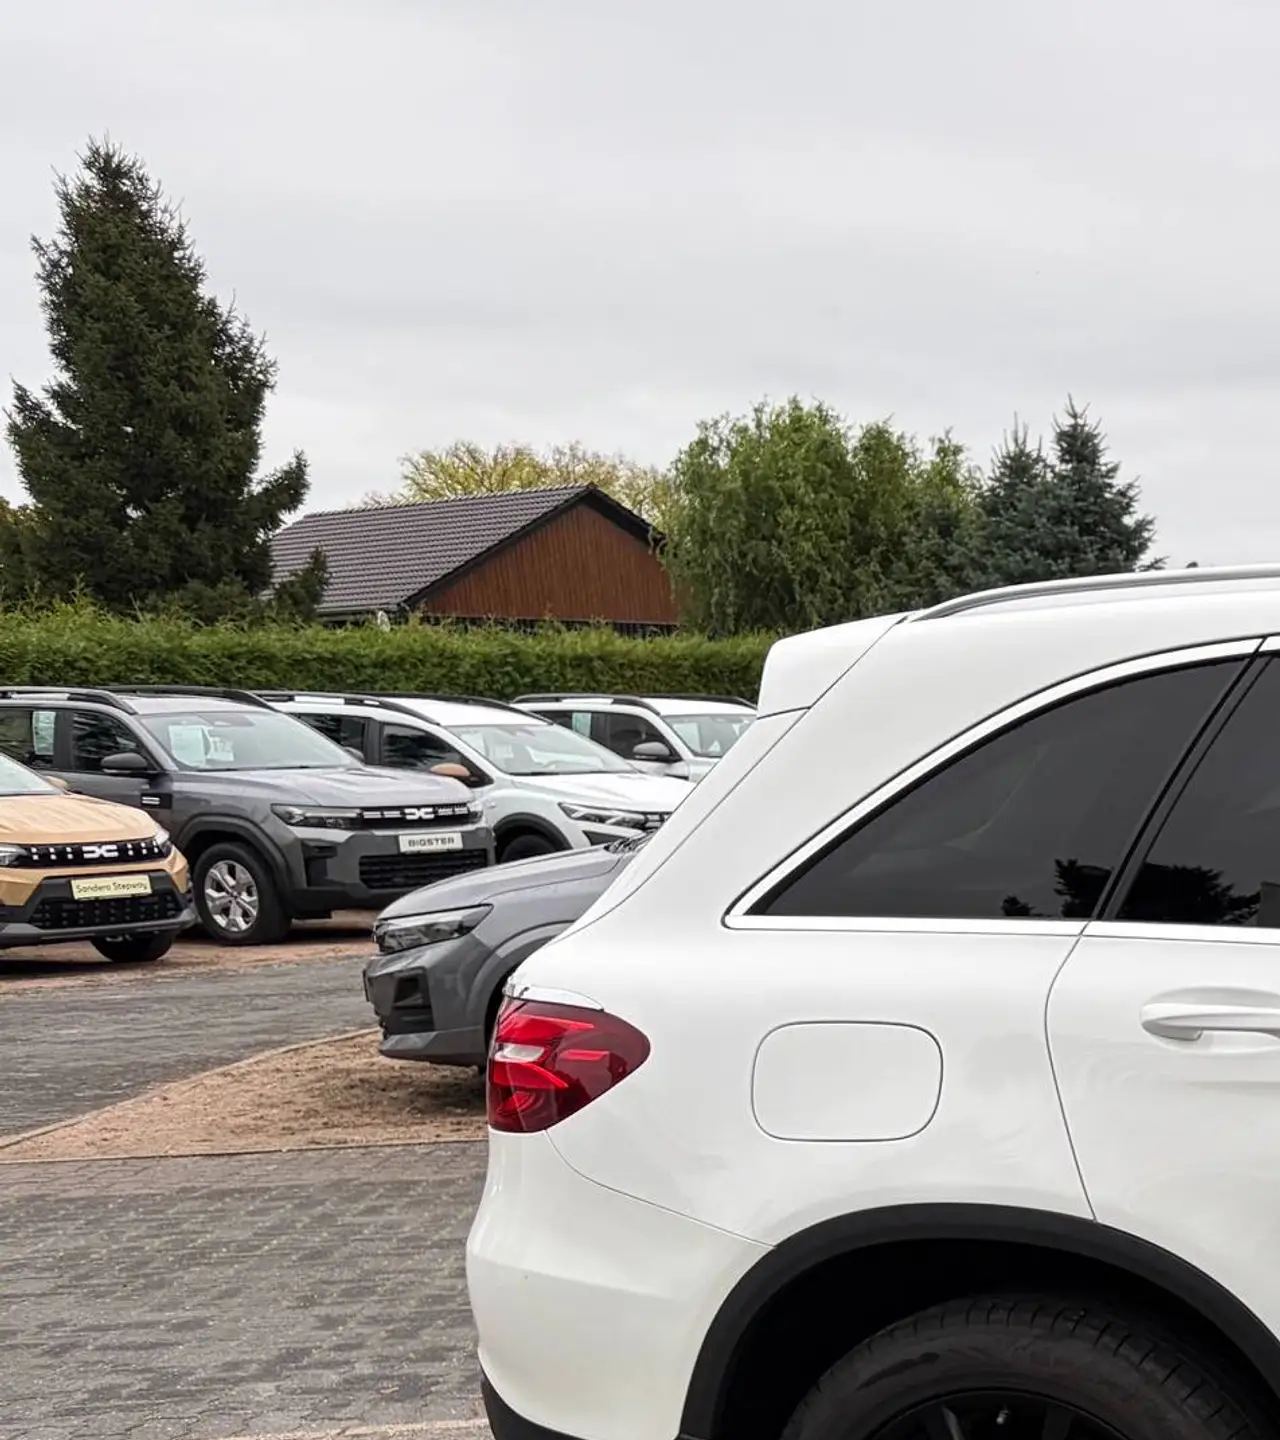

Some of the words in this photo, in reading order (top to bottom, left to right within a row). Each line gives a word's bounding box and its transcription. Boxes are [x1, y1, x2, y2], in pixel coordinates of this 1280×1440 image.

[408, 836, 456, 848] BIGSTER
[76, 883, 111, 894] Sandero
[112, 880, 148, 892] Stepway
